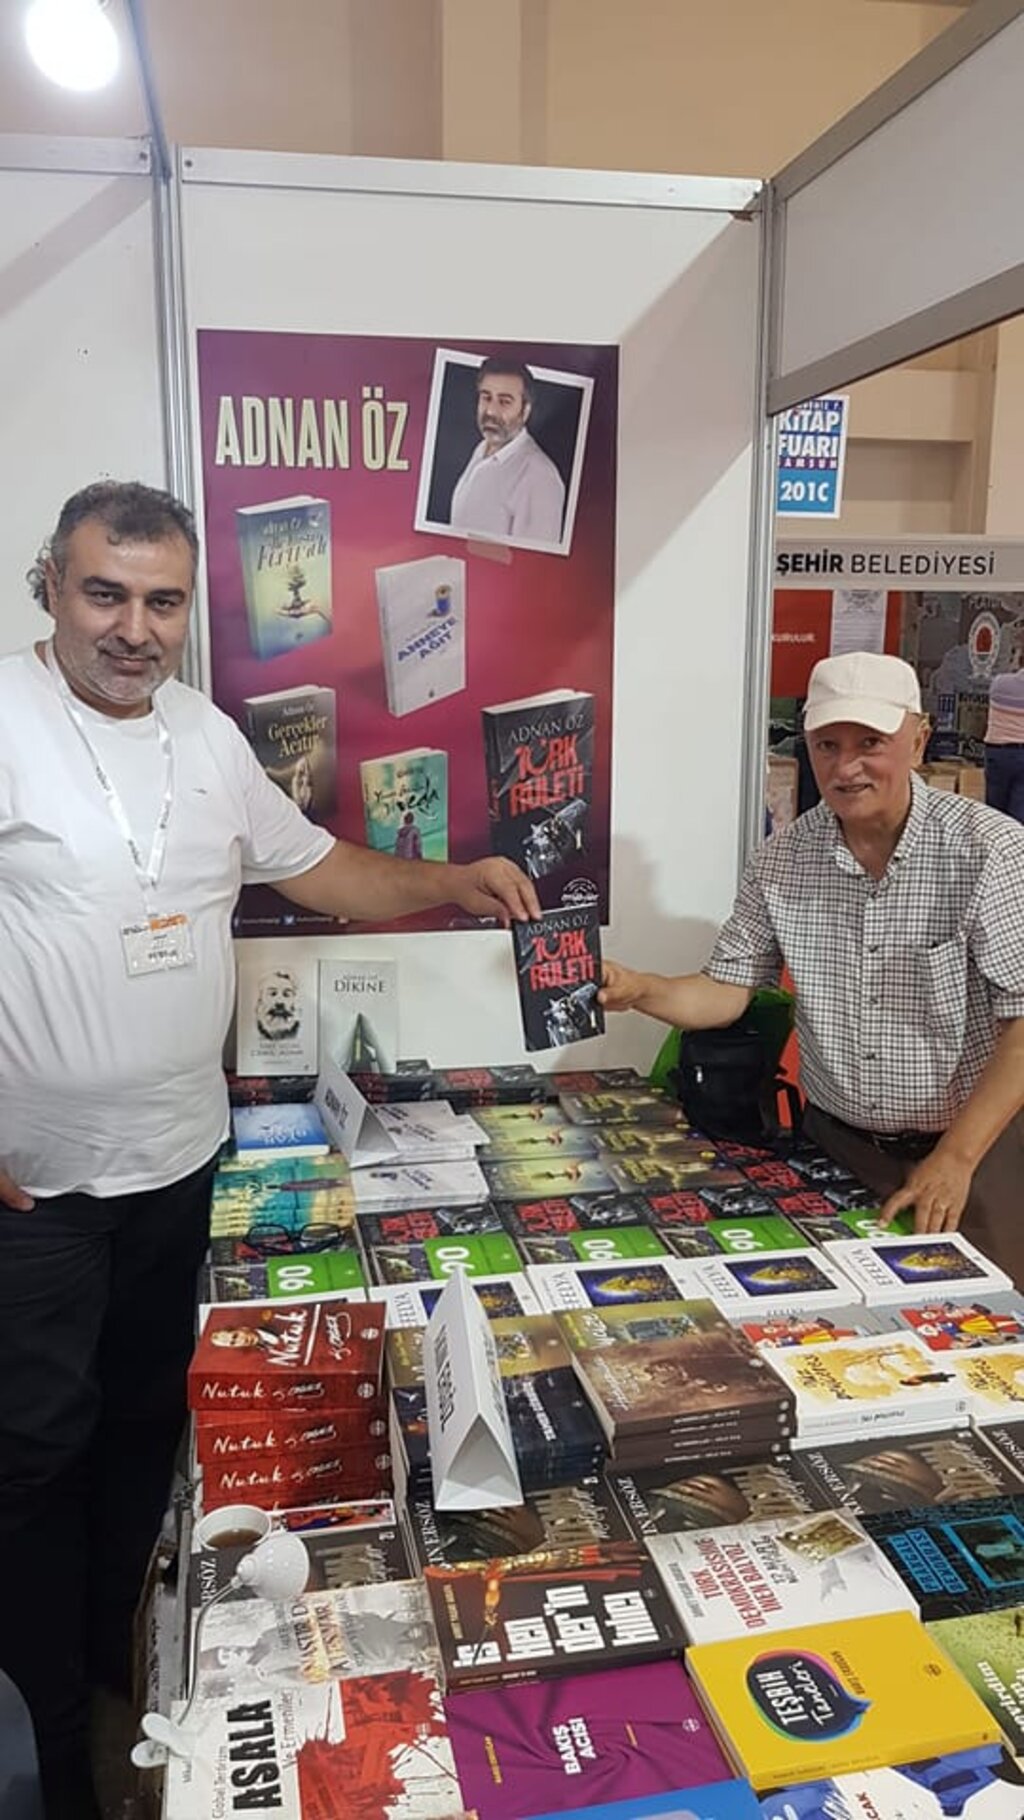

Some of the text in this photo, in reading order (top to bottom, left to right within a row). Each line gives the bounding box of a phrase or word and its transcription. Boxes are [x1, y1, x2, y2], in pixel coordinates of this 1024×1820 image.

[215, 385, 410, 471] ADNAN ÖZ
[779, 409, 840, 432] KİTAP
[778, 434, 838, 457] FUARI
[780, 481, 830, 502] 201C
[776, 550, 995, 576] ŞEHİR BELEDİYESİ
[508, 718, 562, 745] ADNAN
[527, 917, 570, 936] ADNAN
[721, 1229, 763, 1251] 90
[277, 1264, 315, 1291] 90
[267, 1308, 308, 1367] Nutuk
[202, 1381, 267, 1399] Nutuk
[213, 1429, 278, 1454] Nutuk
[220, 1465, 284, 1489] Nutuk
[691, 1570, 722, 1601] TÜRK
[755, 1670, 808, 1727] TEŞBİH
[226, 1700, 283, 1810] ASALA
[552, 1725, 582, 1775] BAKIŞ
